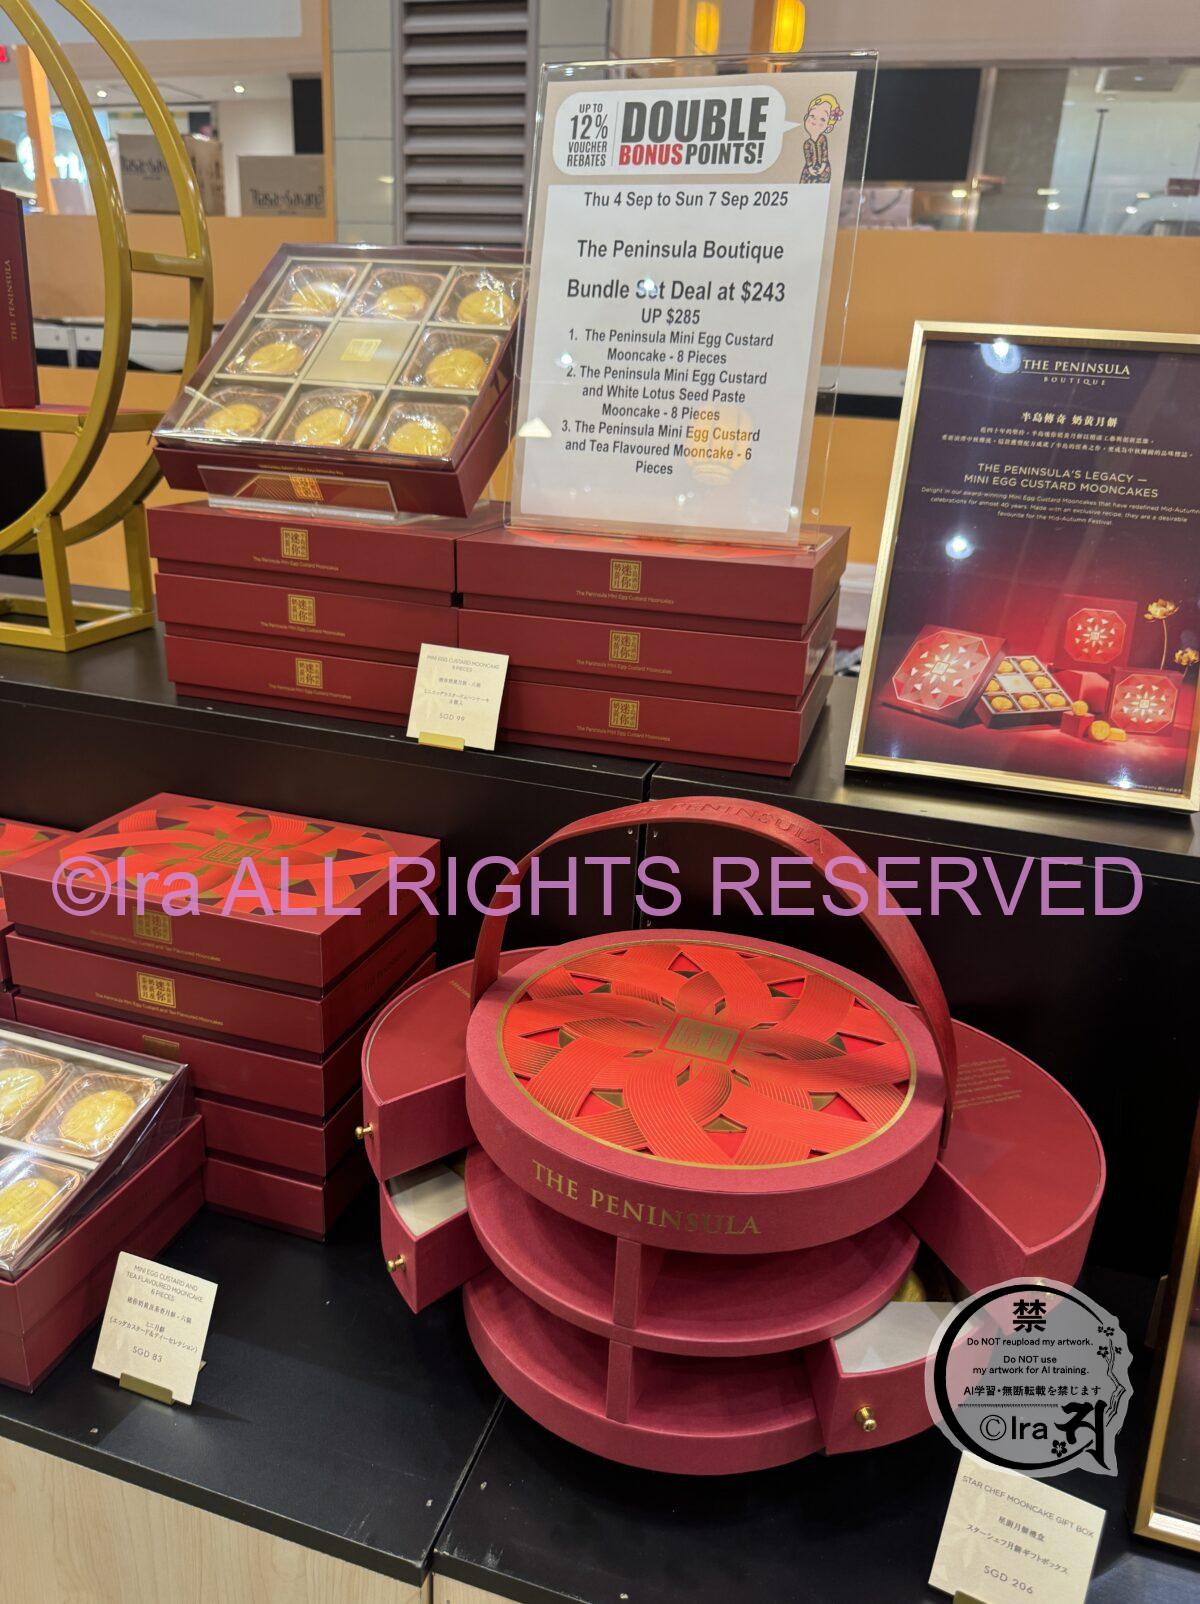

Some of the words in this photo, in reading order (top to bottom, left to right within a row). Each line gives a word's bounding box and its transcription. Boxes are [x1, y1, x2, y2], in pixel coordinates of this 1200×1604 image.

[579, 103, 590, 114] UP
[592, 103, 603, 113] TO
[570, 113, 608, 140] 12%
[621, 97, 769, 143] DOUBLE
[568, 141, 607, 154] VOUCHER
[618, 143, 683, 166] BONUS
[685, 142, 764, 165] POINTS!
[566, 154, 606, 167] REBATES
[584, 192, 609, 207] Thu
[613, 192, 622, 206] 4
[626, 192, 653, 210] Sep
[657, 193, 671, 206] to
[676, 192, 703, 207] Sun
[708, 192, 716, 205] 7
[721, 191, 749, 210] Sep
[753, 191, 788, 206] 2025
[577, 240, 607, 257] The
[613, 240, 697, 259] Peninsula
[703, 241, 784, 262] Boutique
[567, 279, 629, 299] Bundle
[636, 279, 665, 300] Set
[671, 281, 712, 300] Deal
[717, 283, 735, 301] at
[741, 280, 786, 302] $243
[641, 308, 662, 324] UP
[666, 308, 700, 325] $285
[569, 329, 578, 341] 1.
[585, 329, 605, 342] The
[609, 330, 666, 344] Peninsula
[670, 331, 694, 345] Mini
[698, 332, 721, 347] Egg
[725, 332, 774, 347] Custard
[607, 348, 666, 362] Mooncake
[677, 350, 684, 362] 8
[687, 350, 727, 364] Pieces
[566, 366, 576, 378] 2.
[580, 366, 600, 379] The
[604, 366, 660, 381] Peninsula
[664, 368, 688, 382] Mini
[692, 369, 716, 384] Egg
[719, 370, 767, 385] Custard
[1022, 359, 1050, 371] THE
[1054, 361, 1130, 376] PENINSULA
[1043, 376, 1106, 386] BOUTIQUE
[582, 384, 603, 398] and
[606, 385, 639, 400] White
[643, 387, 675, 401] Lotus
[679, 388, 709, 402] Seed
[712, 390, 746, 403] Paste
[602, 404, 661, 418] Mooncake
[671, 407, 678, 419] 8
[681, 407, 720, 421] Pieces
[561, 420, 571, 433] 3.
[575, 420, 595, 434] The
[598, 421, 655, 437] Peninsula
[658, 423, 682, 438] Mini
[686, 425, 709, 441] Egg
[712, 426, 760, 442] Custard
[565, 439, 586, 451] and
[589, 440, 609, 453] Tea
[613, 441, 670, 456] Flavoured
[673, 444, 734, 460] Mooncake
[744, 448, 752, 460] 6
[636, 461, 673, 475] Pieces
[978, 463, 1000, 474] THE
[1004, 465, 1082, 480] PENINSULA'S
[1085, 471, 1134, 484] LEGACY
[964, 474, 989, 485] MINI
[992, 476, 1017, 488] EGG
[1020, 478, 1076, 492] CUSTARD
[1079, 481, 1158, 498] MOONCAKES
[671, 803, 825, 855] PENINSULA
[532, 1159, 579, 1201] THE
[590, 1188, 762, 1235] PENINSULA
[138, 1275, 171, 1291] FLAVOURED
[172, 1286, 203, 1302] MOONCAKE
[159, 1273, 186, 1287] CUSTARD
[185, 1282, 198, 1291] AND
[132, 1346, 150, 1358] SGD
[152, 1353, 163, 1363] 83
[962, 1475, 983, 1489] STAR
[984, 1484, 1006, 1498] CHEF
[1006, 1494, 1055, 1520] MOONCAKE
[1055, 1516, 1074, 1529] GIFT
[1076, 1525, 1095, 1538] BOX
[984, 1565, 1008, 1583] SGD
[1012, 1578, 1033, 1595] 206
